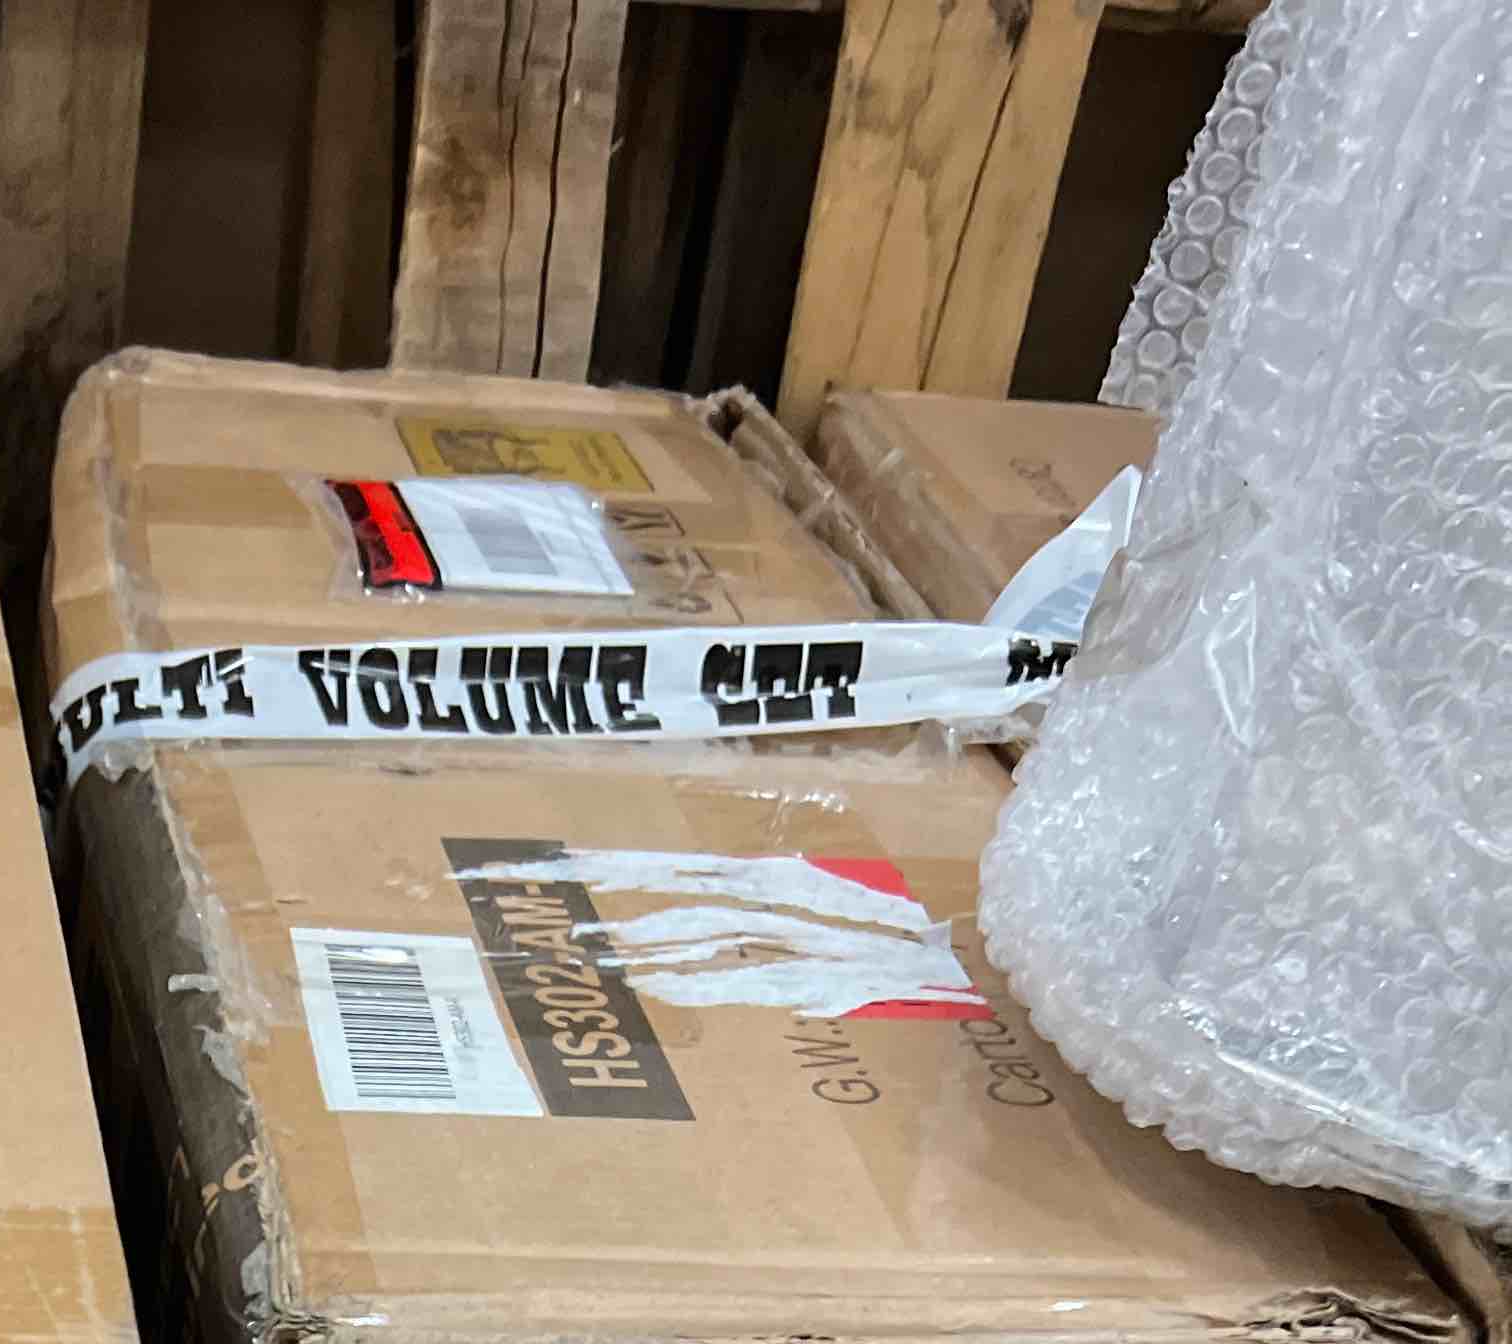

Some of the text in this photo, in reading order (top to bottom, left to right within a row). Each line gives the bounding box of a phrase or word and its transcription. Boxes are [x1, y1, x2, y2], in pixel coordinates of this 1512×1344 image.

[60, 648, 254, 753] ULTI
[297, 643, 661, 736] VOLUME
[959, 1019, 1055, 1106] Carto
